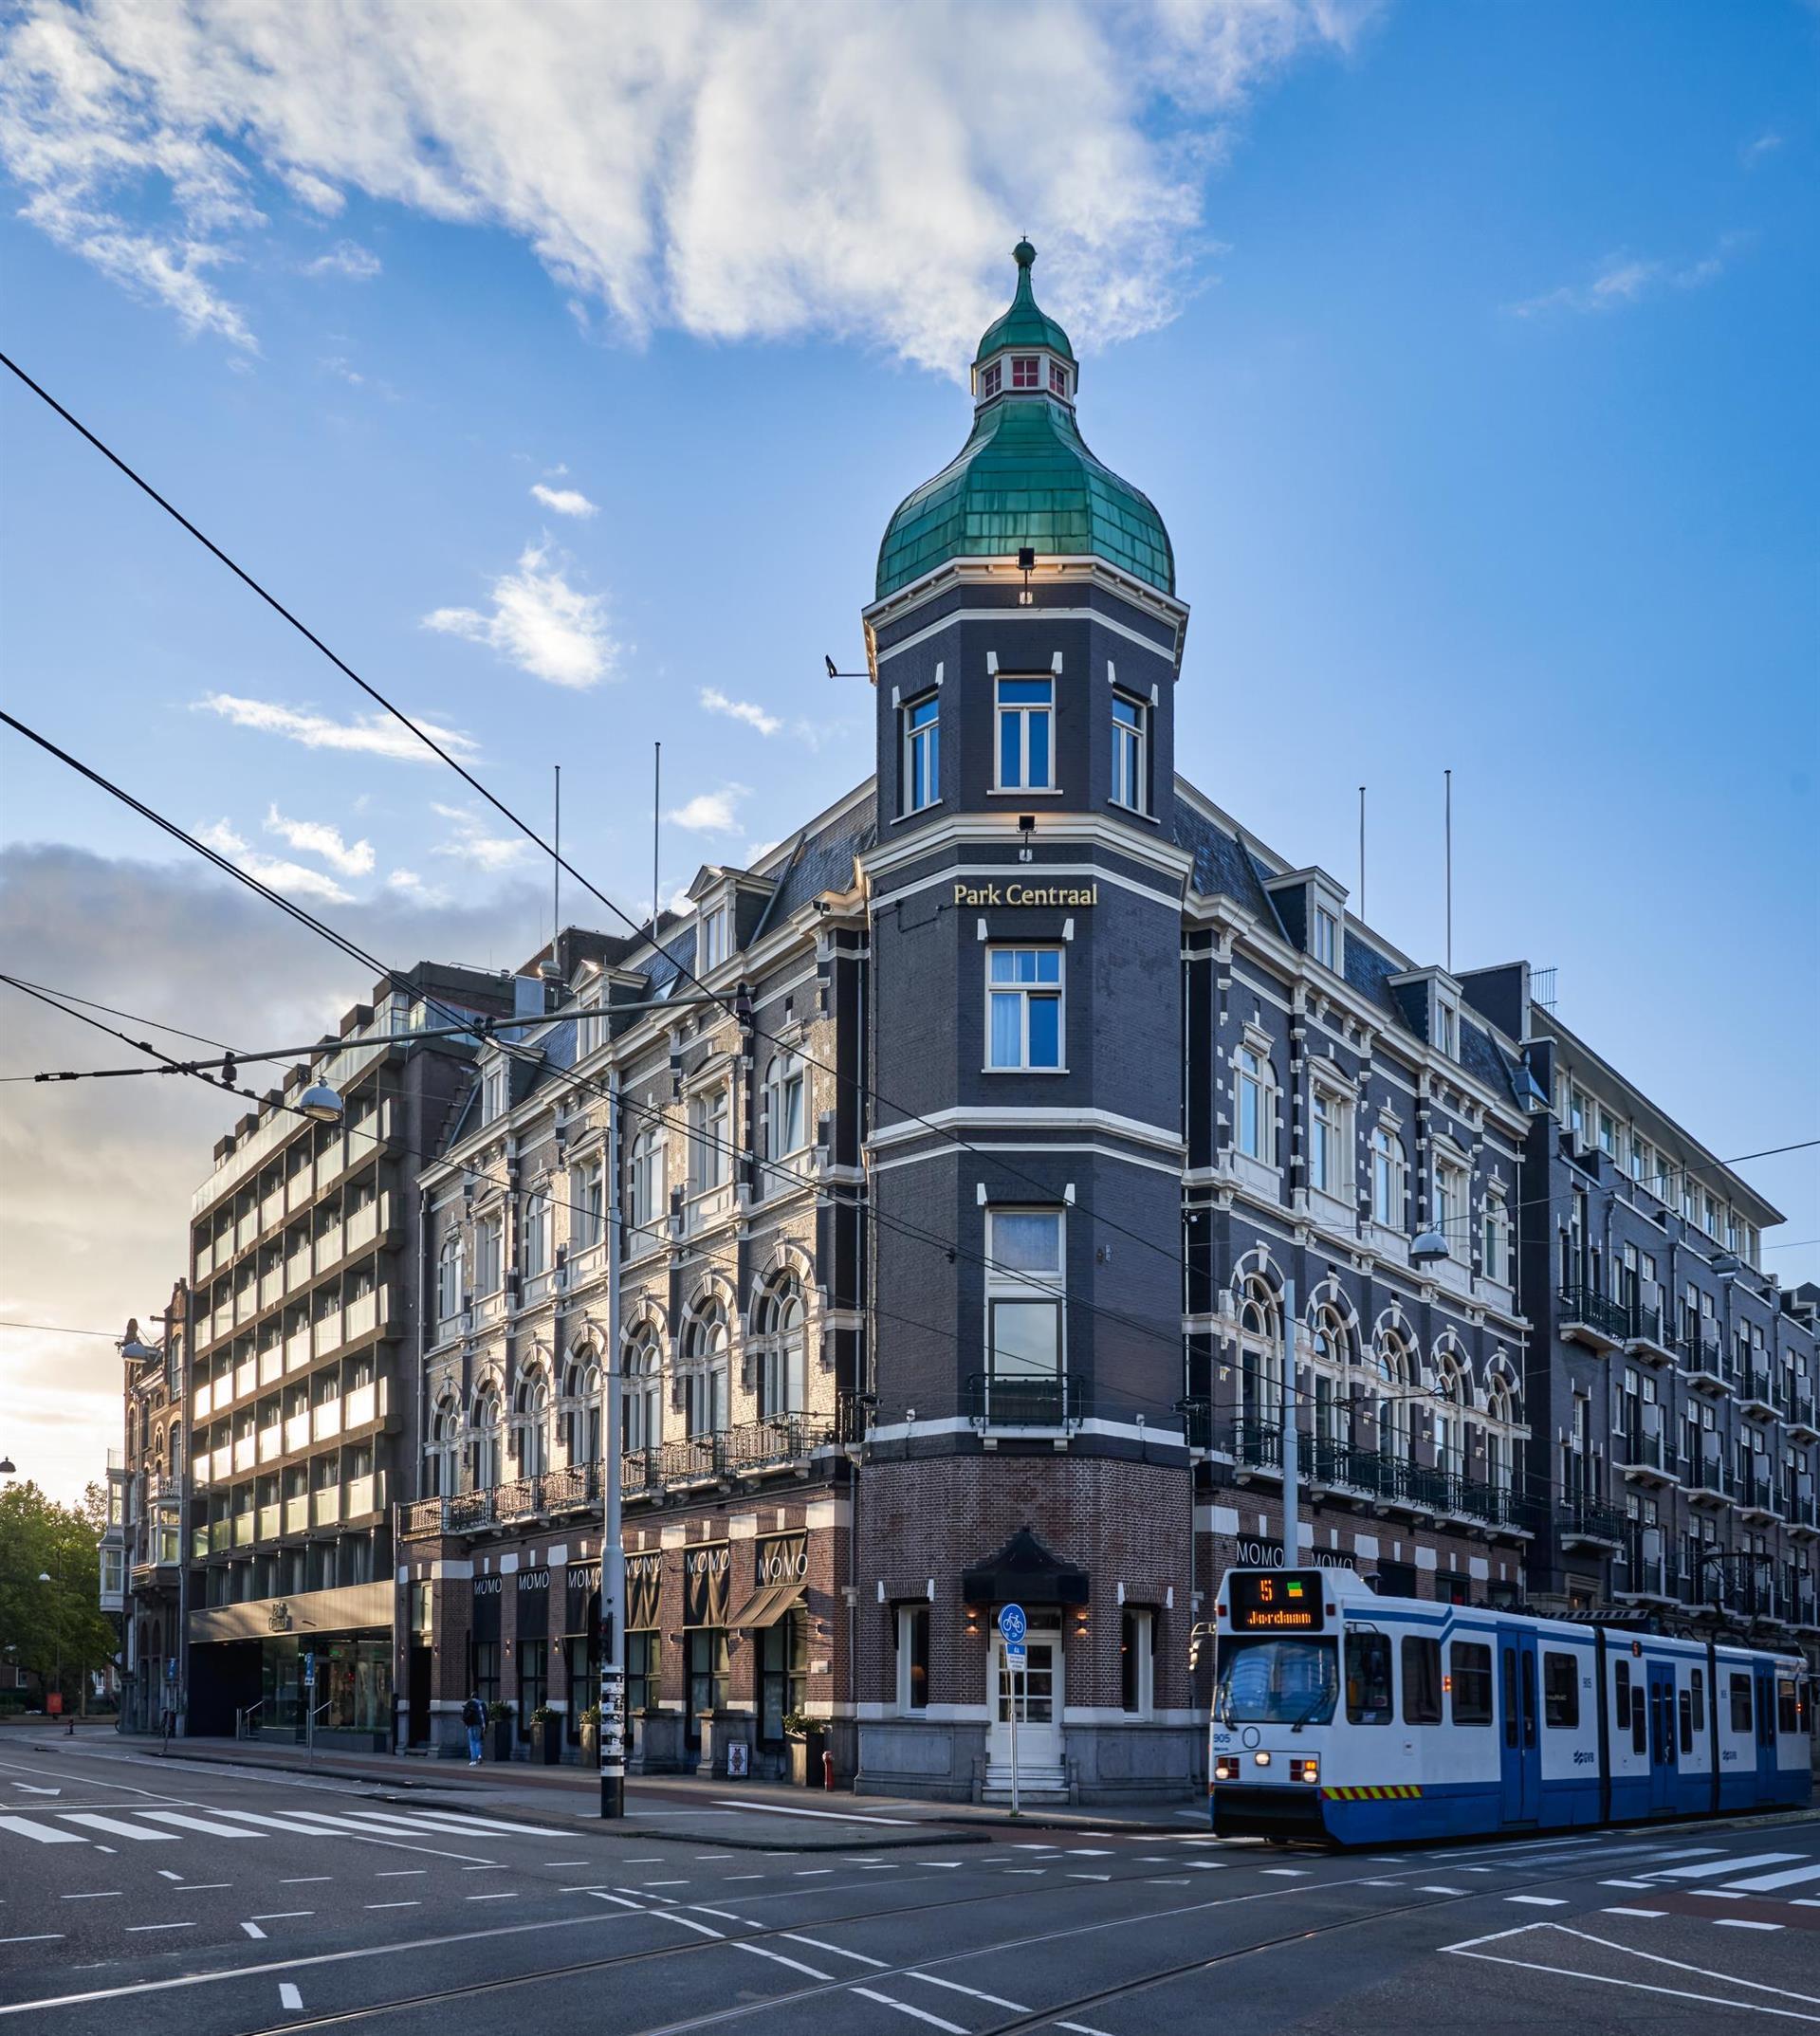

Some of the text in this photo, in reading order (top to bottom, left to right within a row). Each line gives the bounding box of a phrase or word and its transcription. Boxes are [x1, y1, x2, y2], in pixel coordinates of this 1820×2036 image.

[954, 883, 1098, 906] Park Centraal
[625, 1554, 662, 1575] MOMO
[687, 1550, 730, 1574] MOMO
[1237, 1541, 1284, 1568] MOMO
[760, 1553, 808, 1579] MOMO
[474, 1577, 503, 1594] MOMO
[519, 1569, 549, 1590] MOMO
[569, 1567, 602, 1588] MOMO
[1260, 1579, 1272, 1602] 5
[1213, 1733, 1231, 1743] 905
